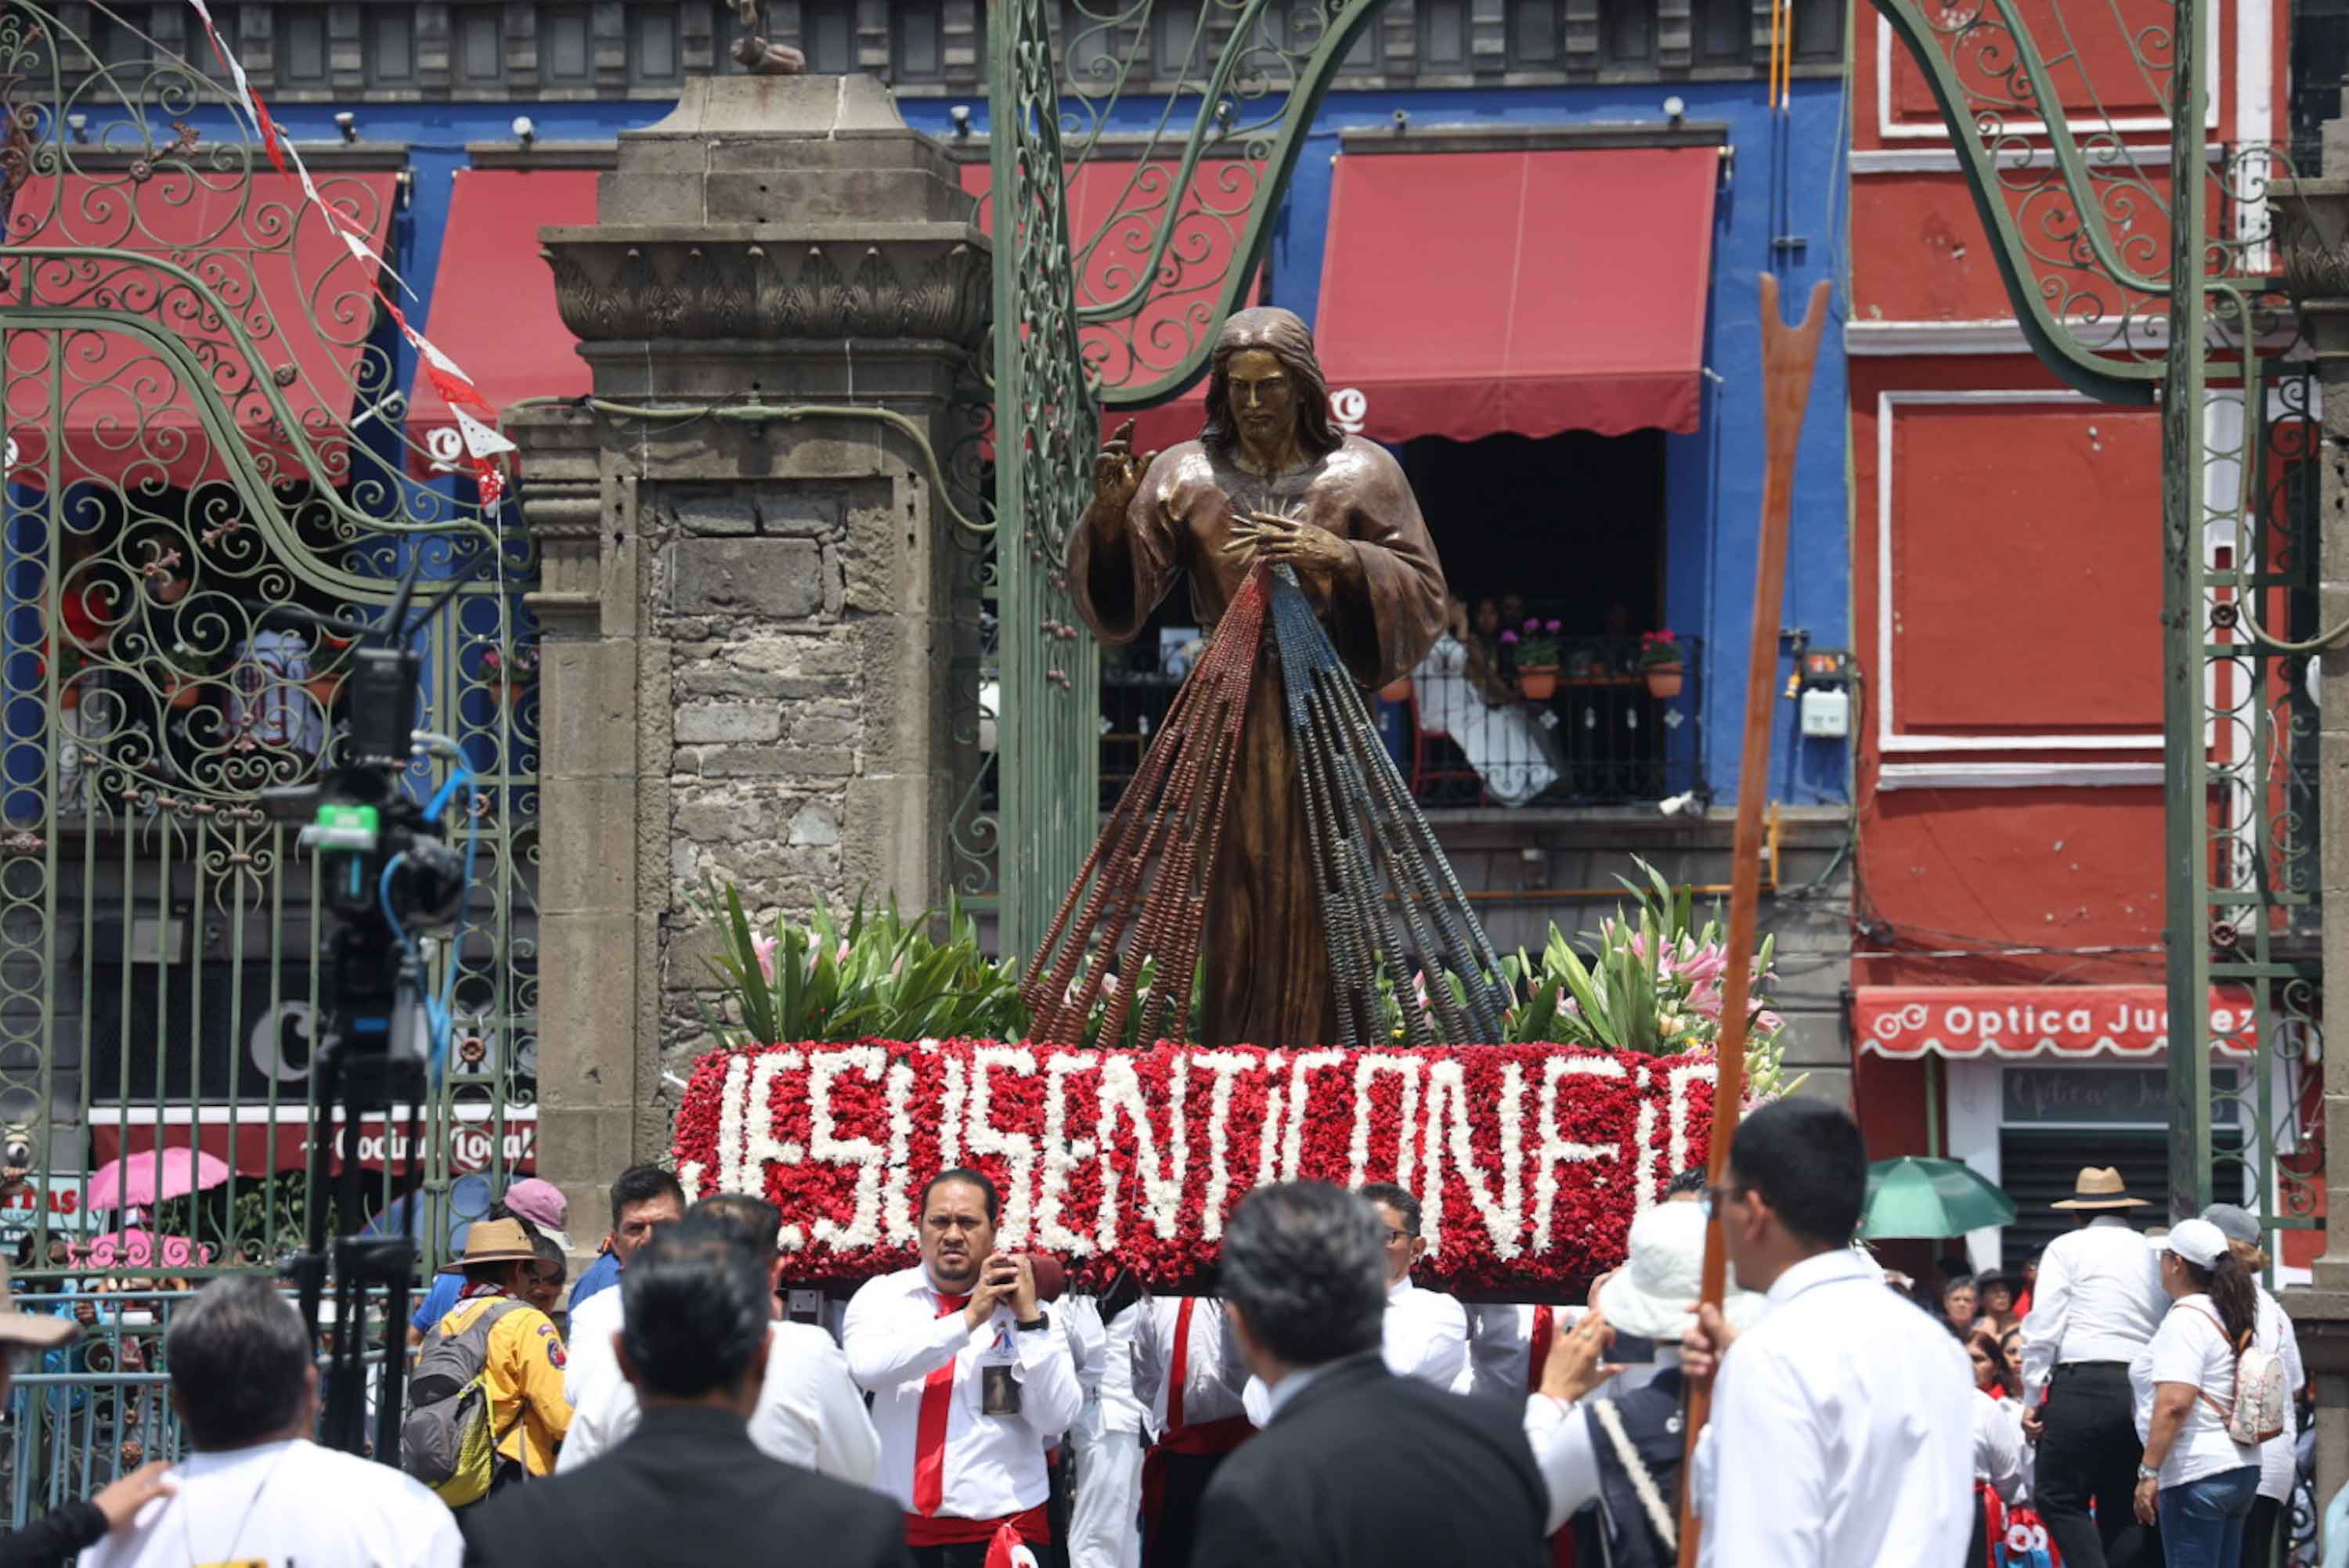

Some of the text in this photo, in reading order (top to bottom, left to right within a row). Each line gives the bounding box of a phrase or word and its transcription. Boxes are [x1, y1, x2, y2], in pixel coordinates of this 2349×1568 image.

[1944, 1004, 2255, 1038] Optica Juez
[1034, 1051, 1189, 1256] EN
